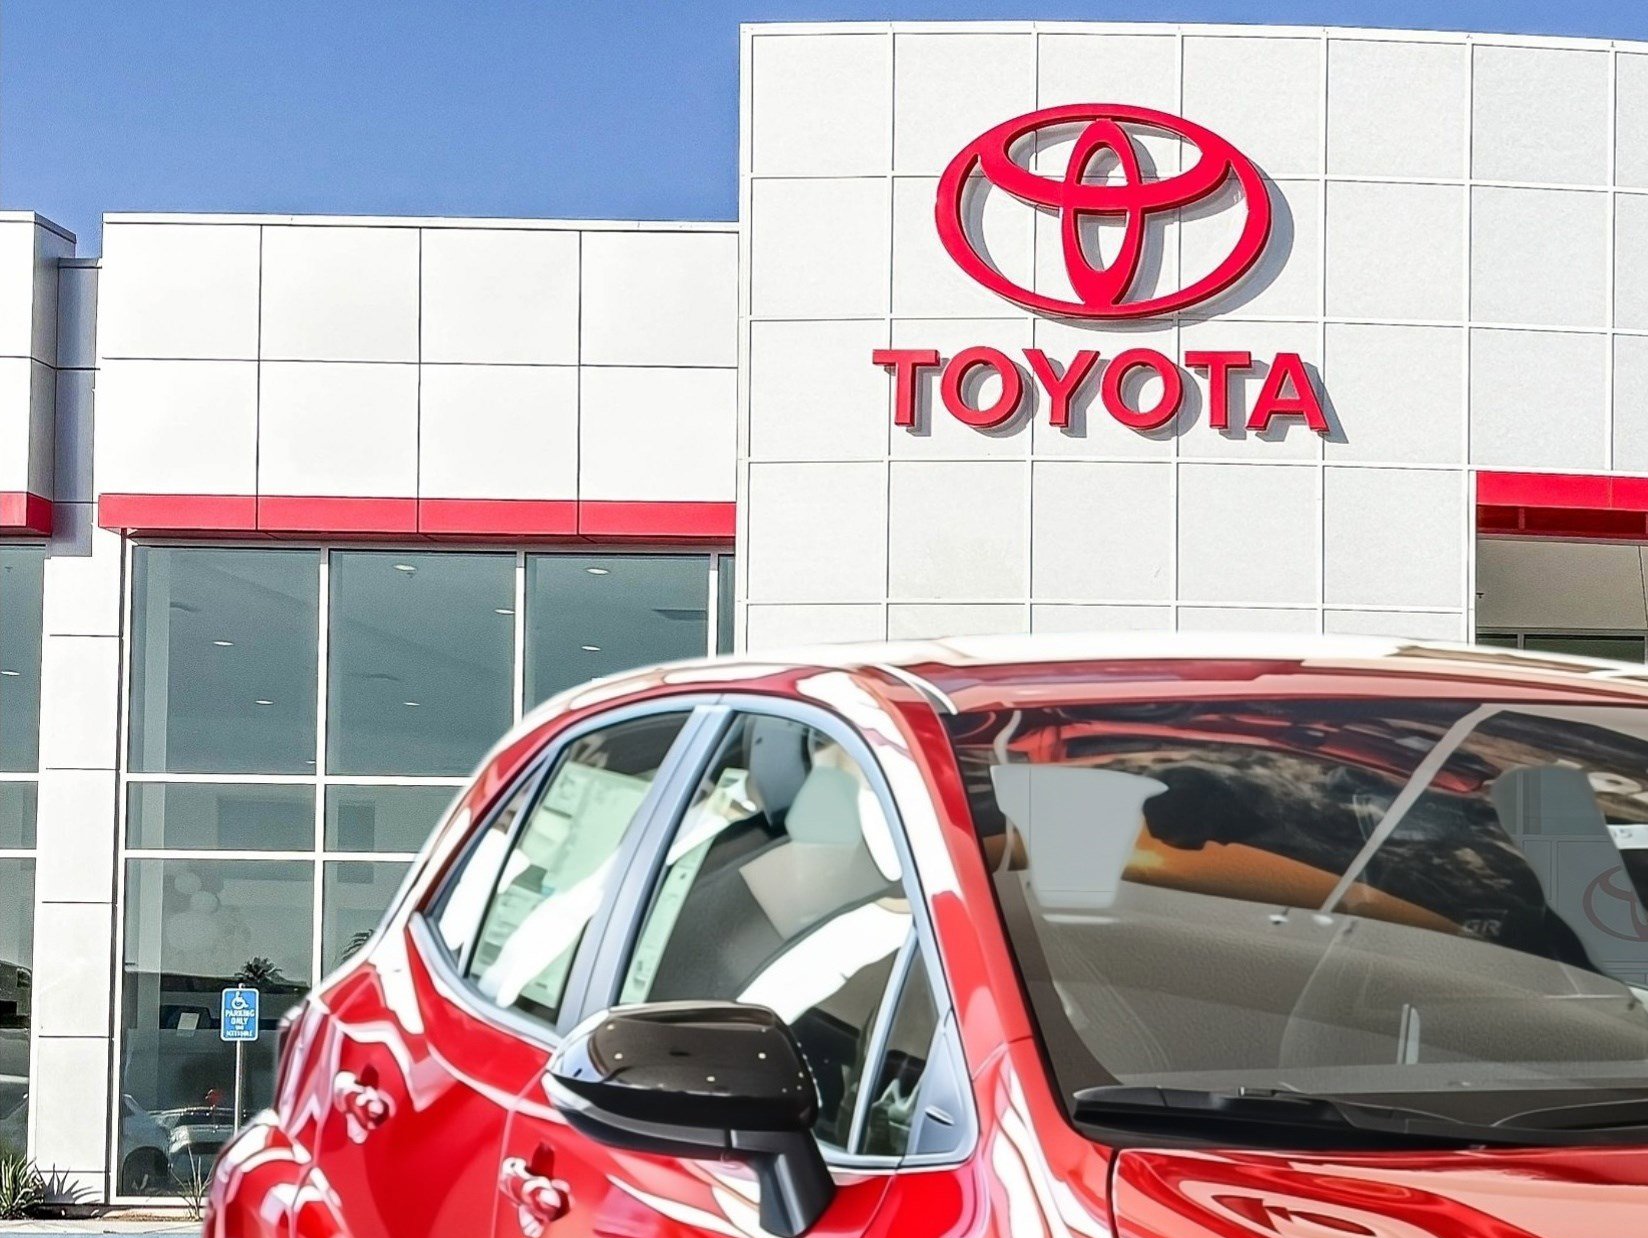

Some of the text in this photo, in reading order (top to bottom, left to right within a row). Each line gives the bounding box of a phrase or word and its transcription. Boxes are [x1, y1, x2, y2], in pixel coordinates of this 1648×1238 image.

[872, 345, 1331, 433] TOYOTA
[225, 1009, 255, 1017] PARKING
[231, 1017, 249, 1025] ONLY
